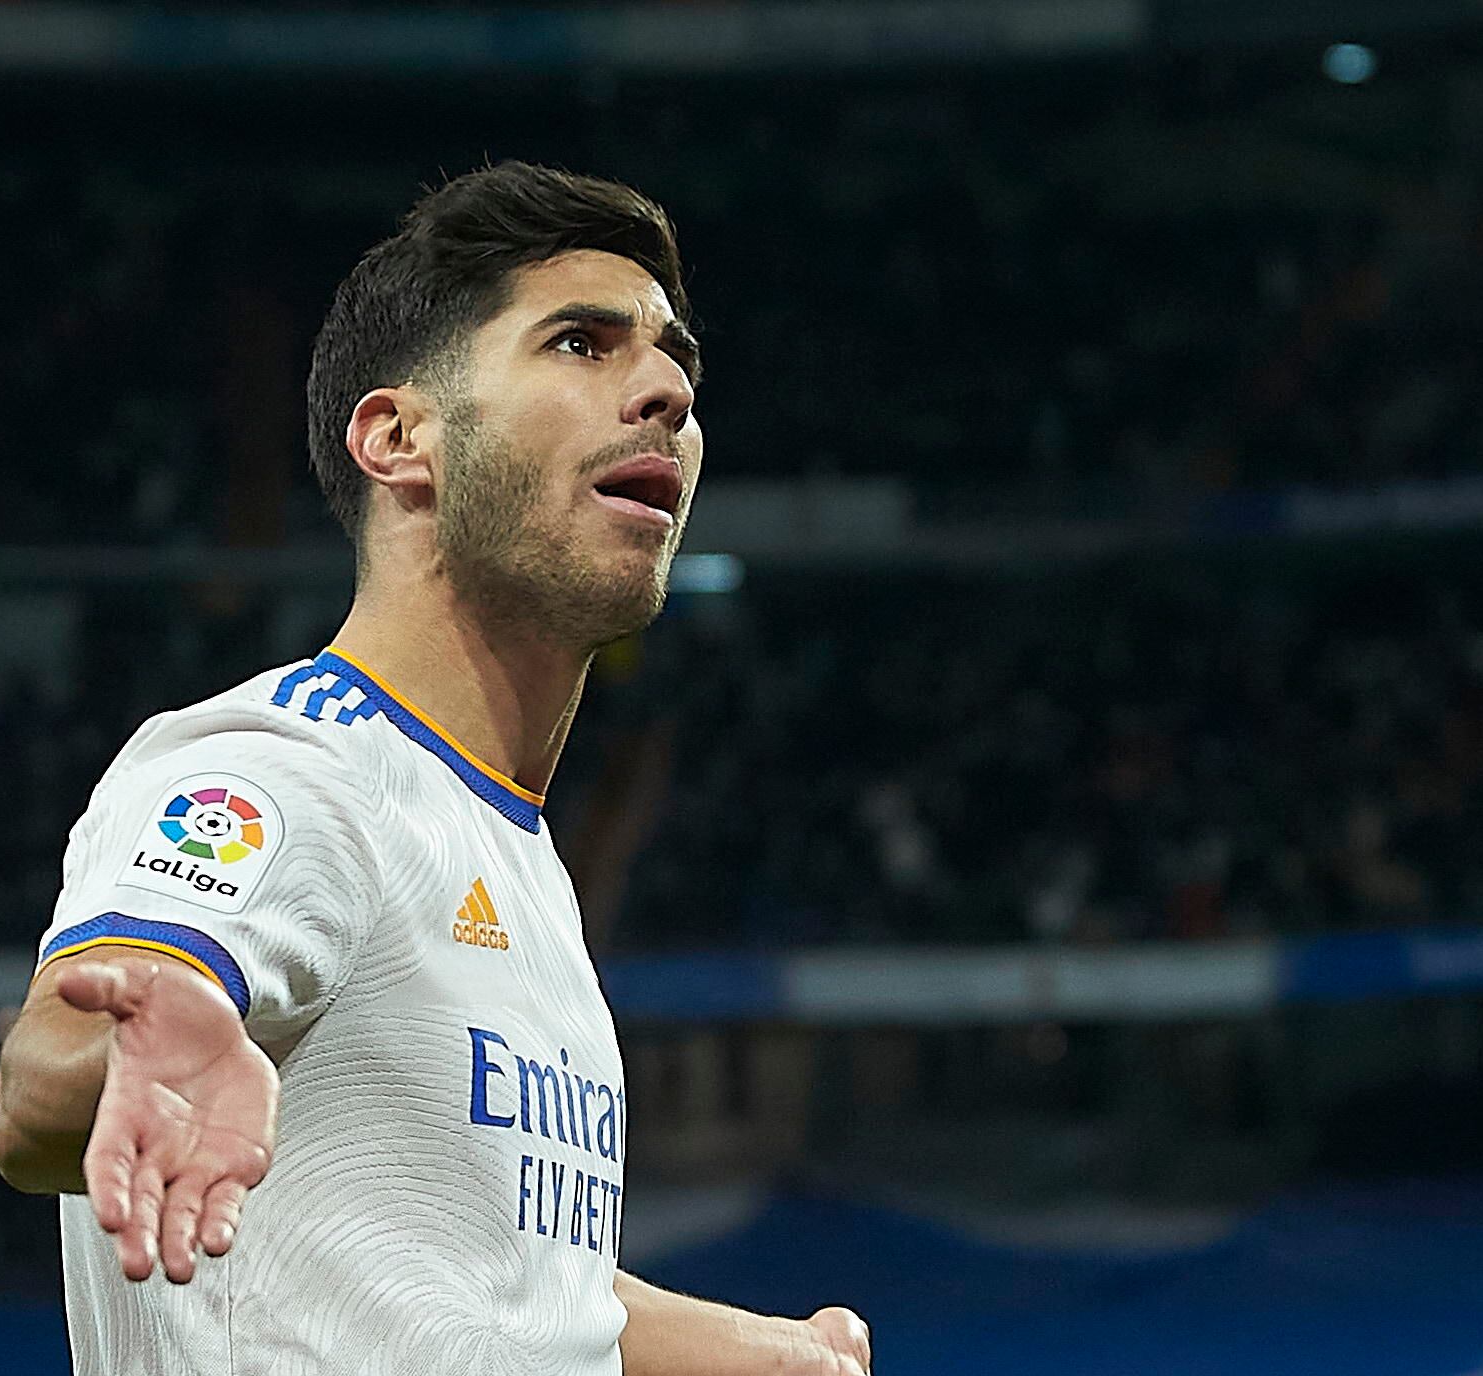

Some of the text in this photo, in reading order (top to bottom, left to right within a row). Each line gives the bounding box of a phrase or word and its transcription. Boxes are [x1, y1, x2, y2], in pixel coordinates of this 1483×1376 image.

[133, 851, 239, 898] LaLiga
[453, 922, 509, 950] adidas
[518, 1154, 565, 1239] FLY
